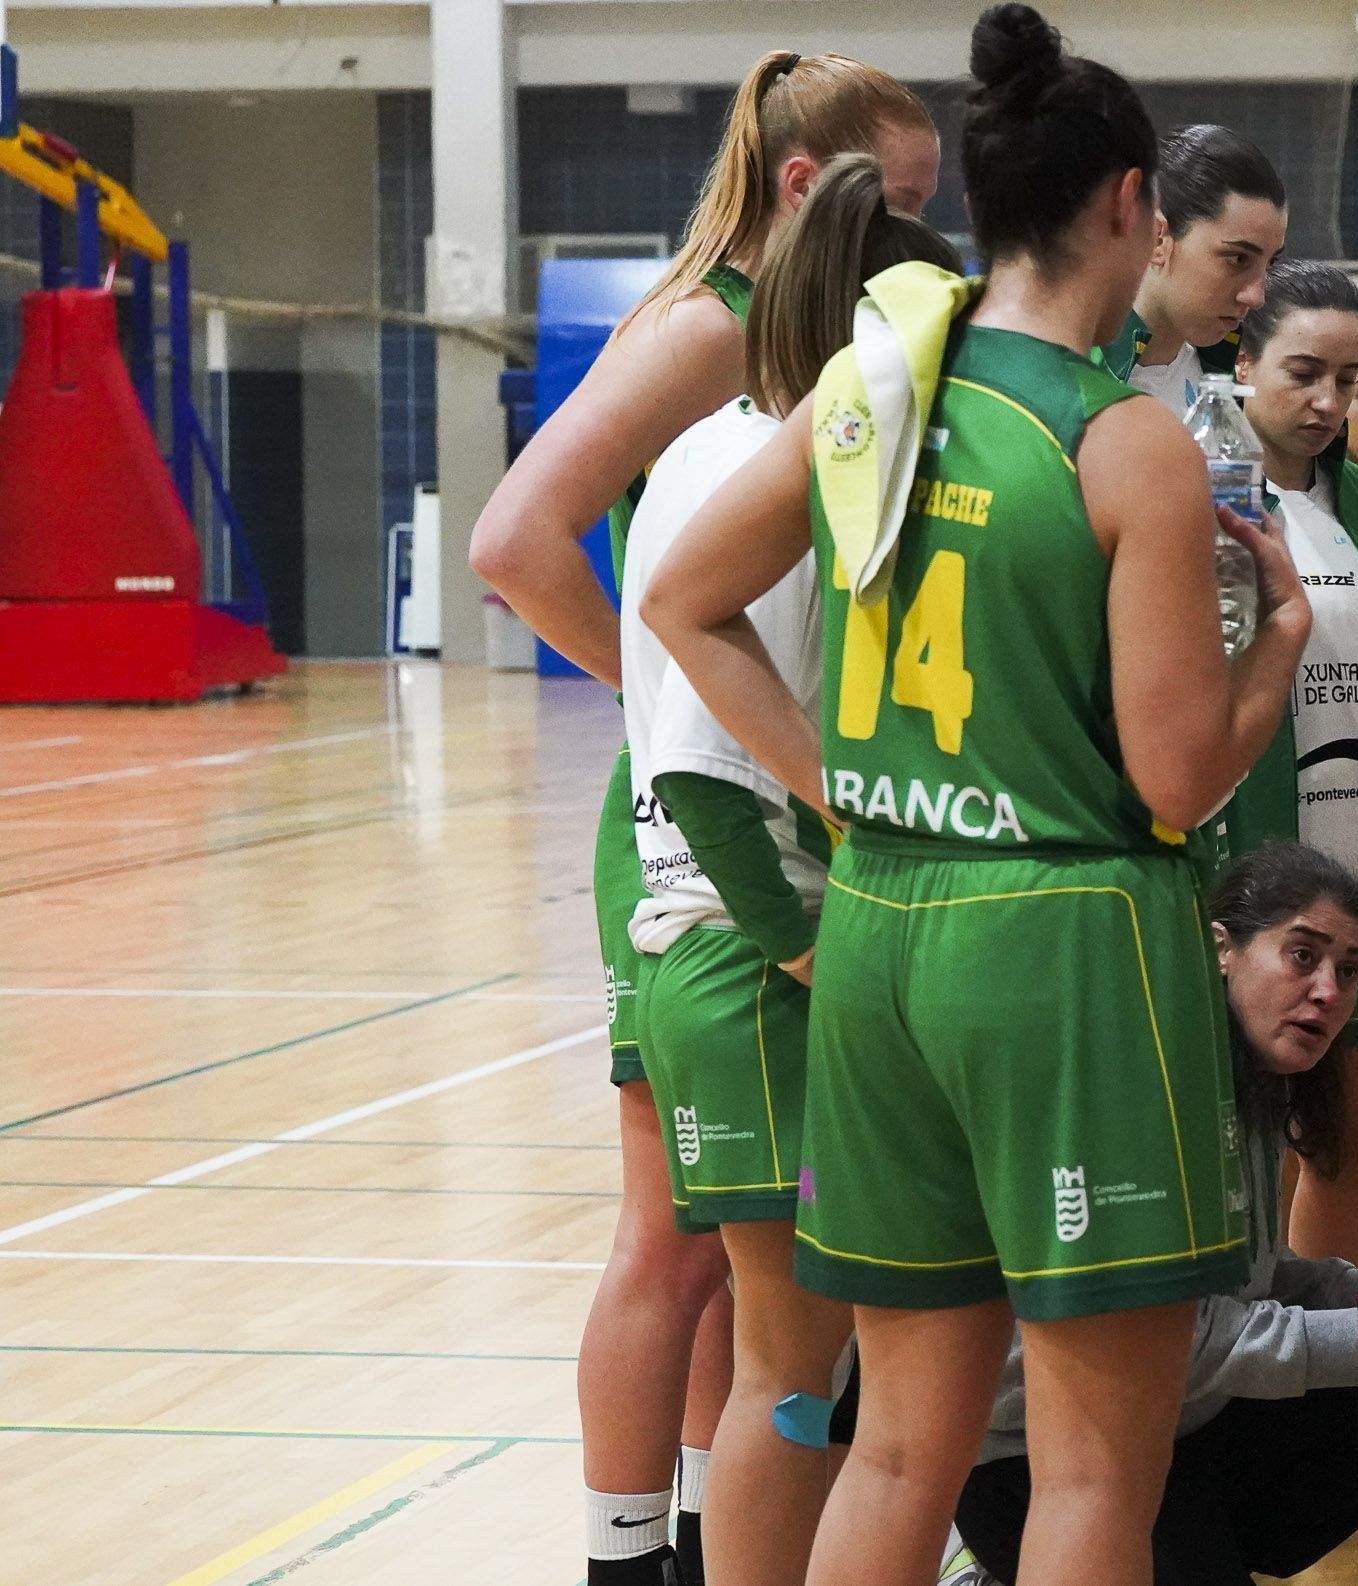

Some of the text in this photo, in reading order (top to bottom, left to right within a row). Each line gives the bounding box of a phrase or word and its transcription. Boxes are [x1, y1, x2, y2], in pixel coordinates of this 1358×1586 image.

[833, 550, 974, 756] 14
[1303, 663, 1358, 682] XUNTA
[1304, 686, 1328, 705] DE
